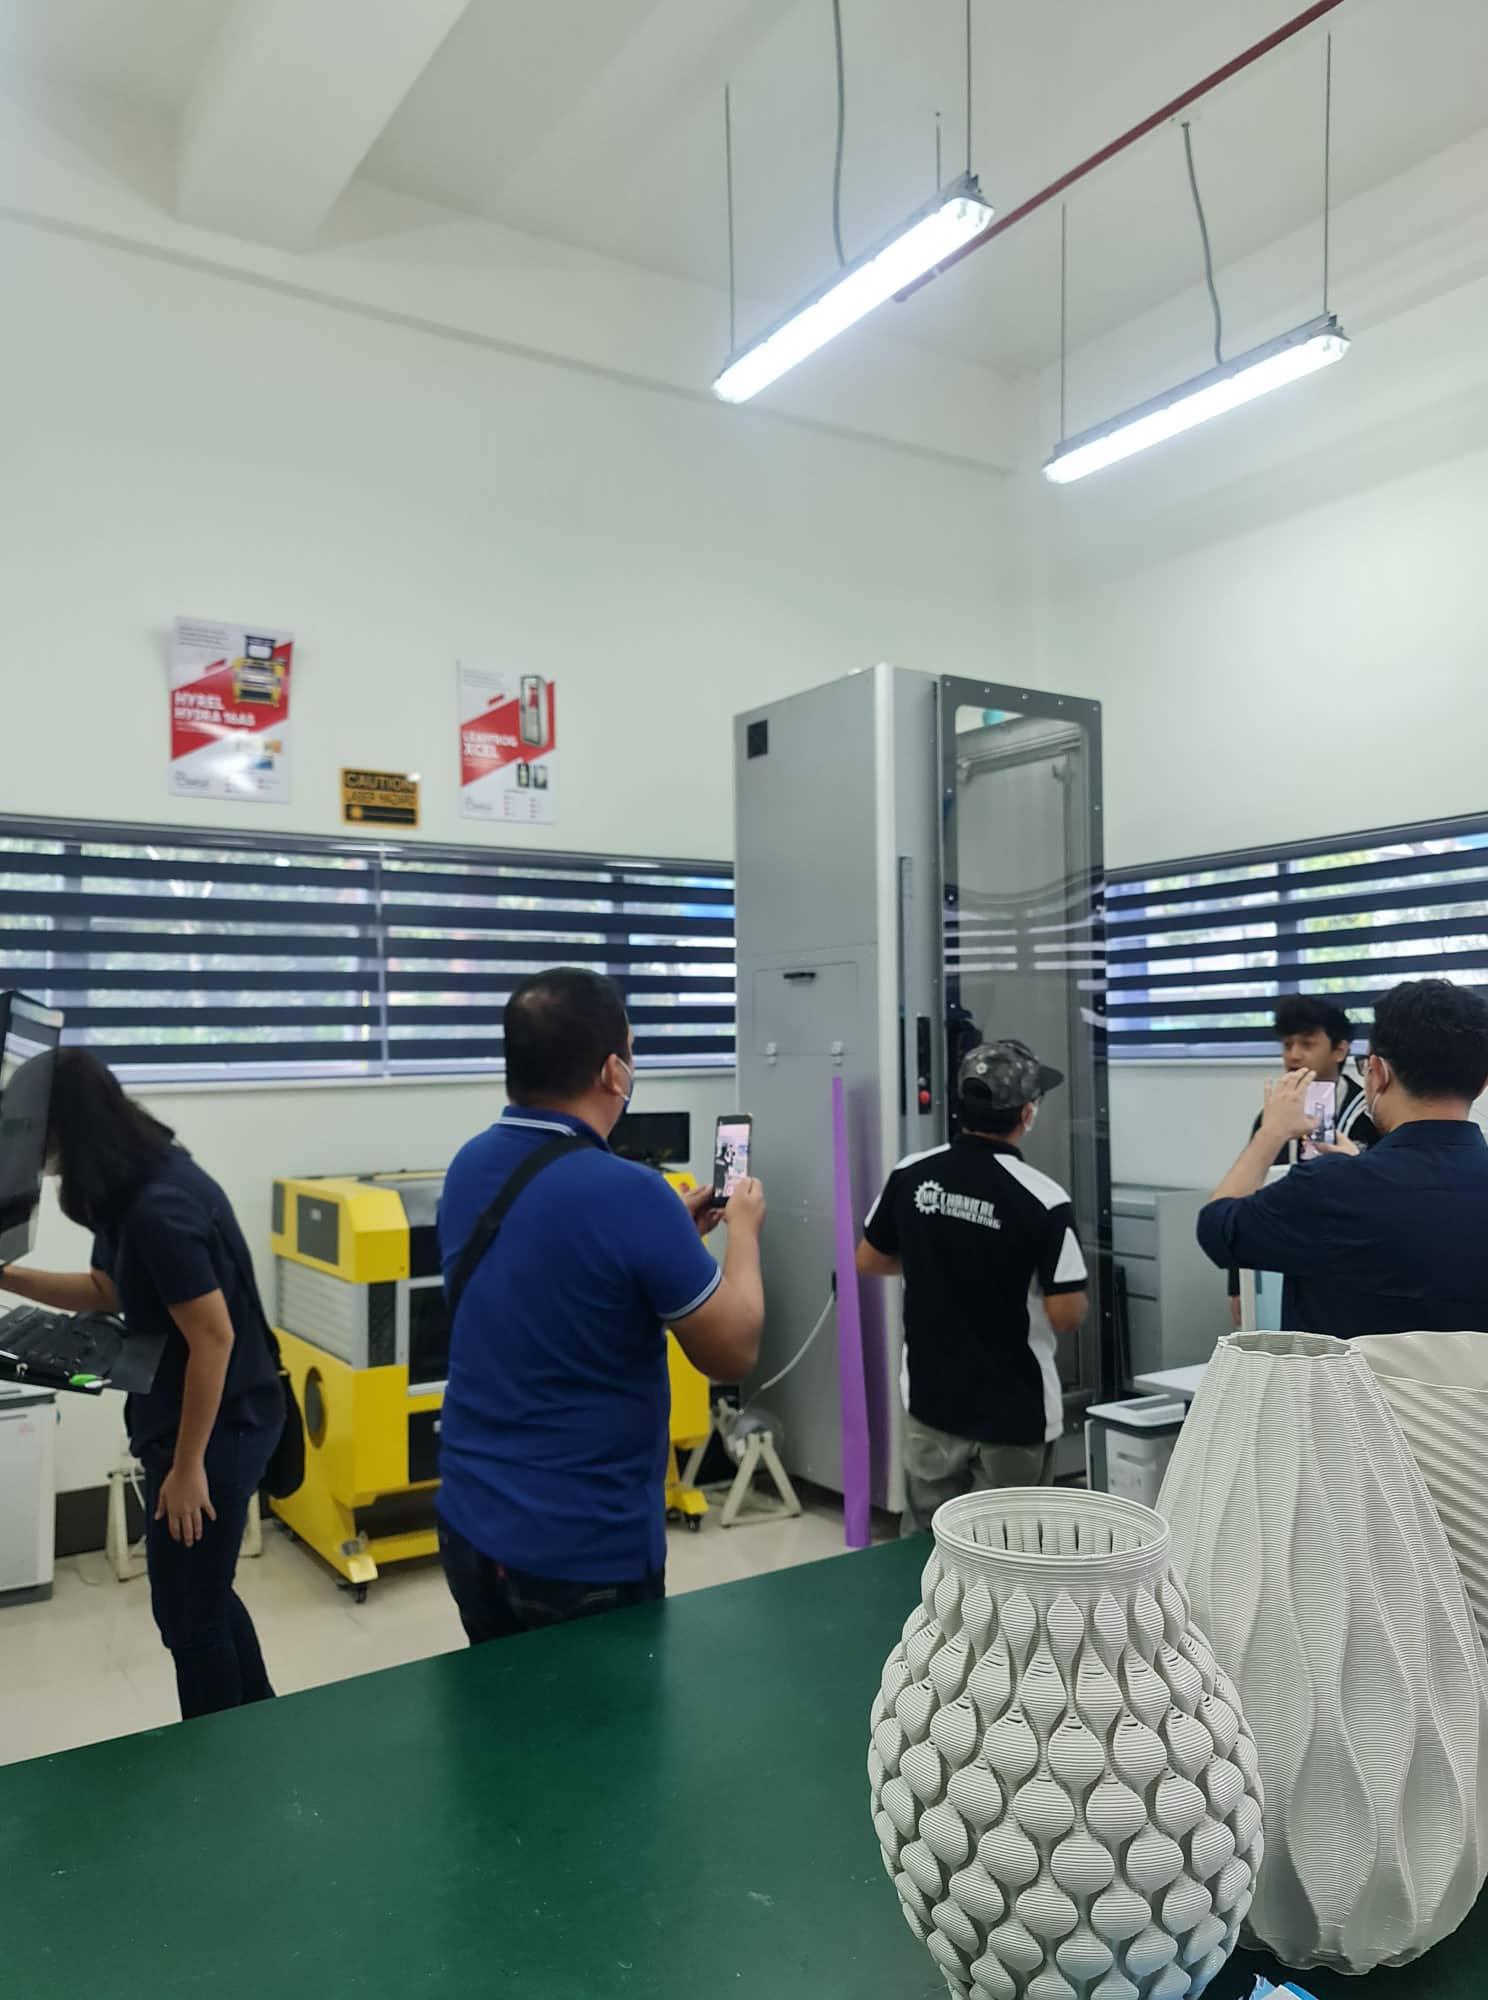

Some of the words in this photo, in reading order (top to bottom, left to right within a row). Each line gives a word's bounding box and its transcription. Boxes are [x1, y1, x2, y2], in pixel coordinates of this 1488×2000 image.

[174, 691, 225, 710] HYREL
[174, 707, 222, 723] HYDRA
[346, 773, 416, 792] CAUTION
[920, 1190, 995, 1218] MECHANICAL
